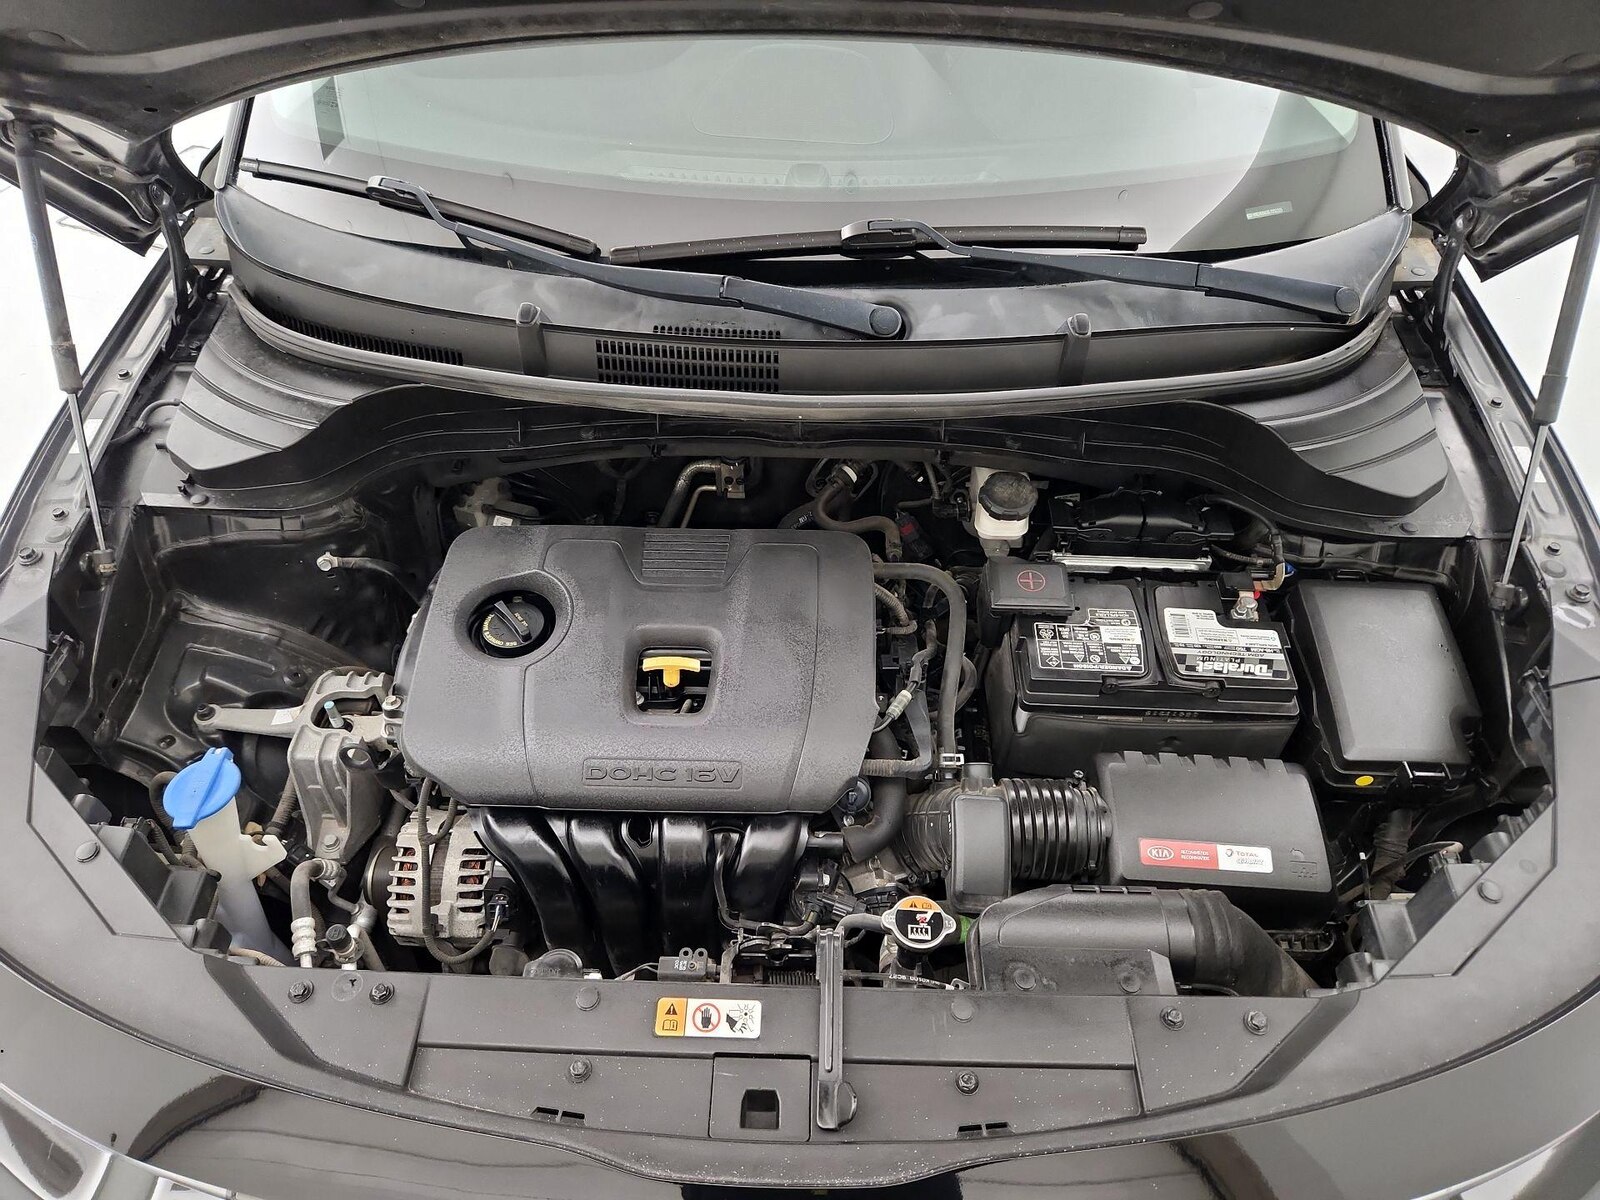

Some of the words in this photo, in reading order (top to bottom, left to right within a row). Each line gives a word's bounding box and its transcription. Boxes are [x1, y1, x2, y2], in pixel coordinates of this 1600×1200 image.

[1197, 650, 1246, 658] TECHNOLOGY
[1196, 661, 1273, 677] Duralast
[585, 766, 677, 783] DOHC
[685, 767, 741, 784] 16V
[1235, 850, 1259, 858] TOTAL
